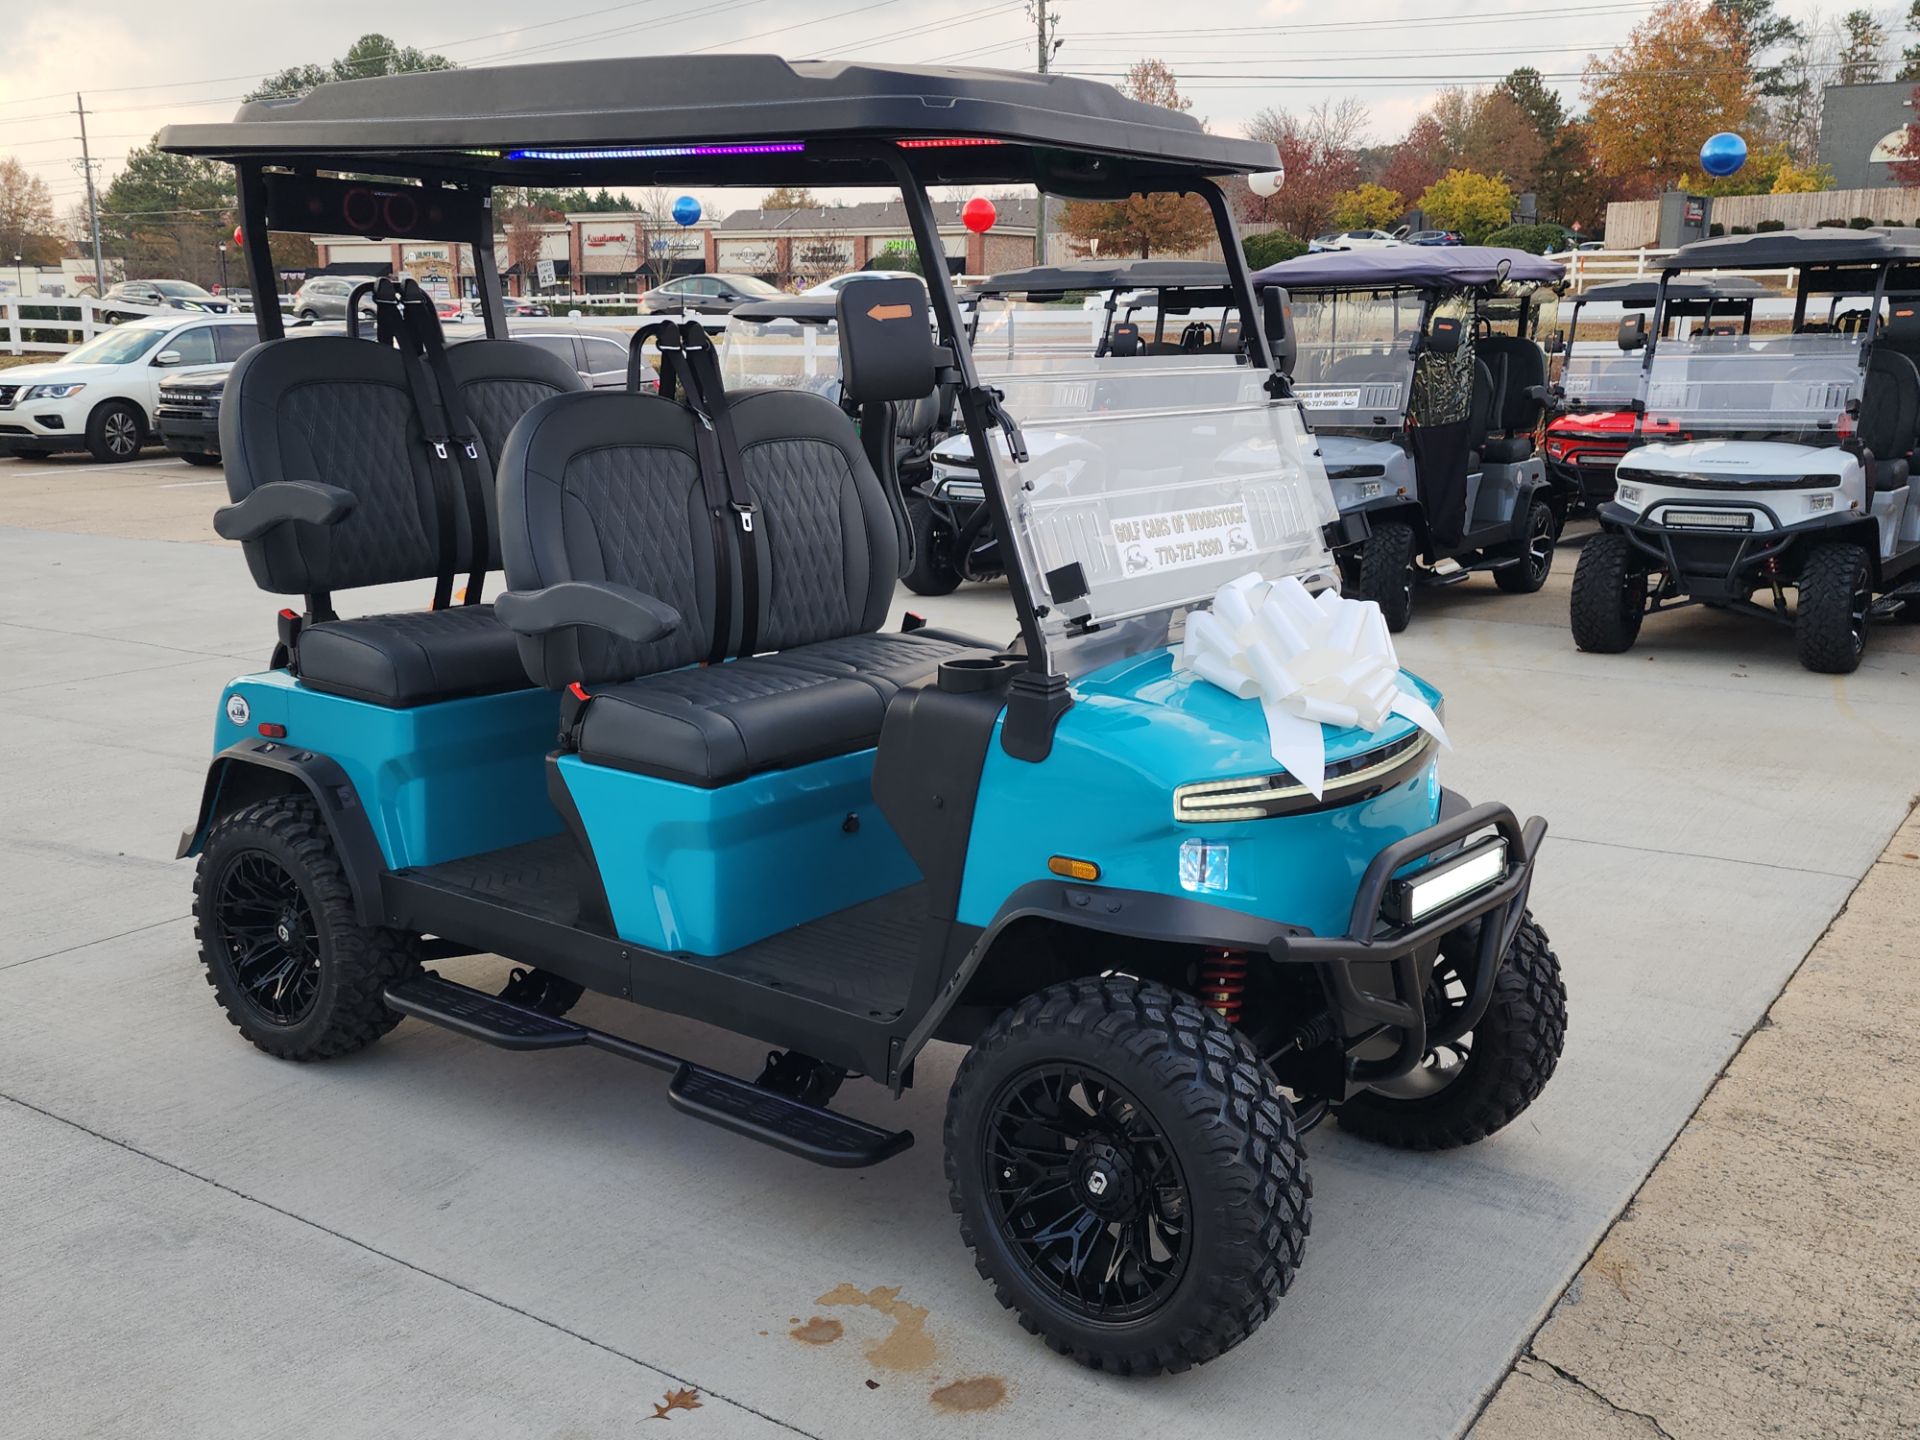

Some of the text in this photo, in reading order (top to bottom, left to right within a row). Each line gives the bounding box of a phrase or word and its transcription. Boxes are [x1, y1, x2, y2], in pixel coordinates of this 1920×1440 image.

[541, 273, 554, 284] 45
[161, 392, 203, 401] BRONCO
[1323, 390, 1359, 398] WOODSTOCK
[1115, 506, 1246, 543] GOLF CARS OF WOODSTOCK
